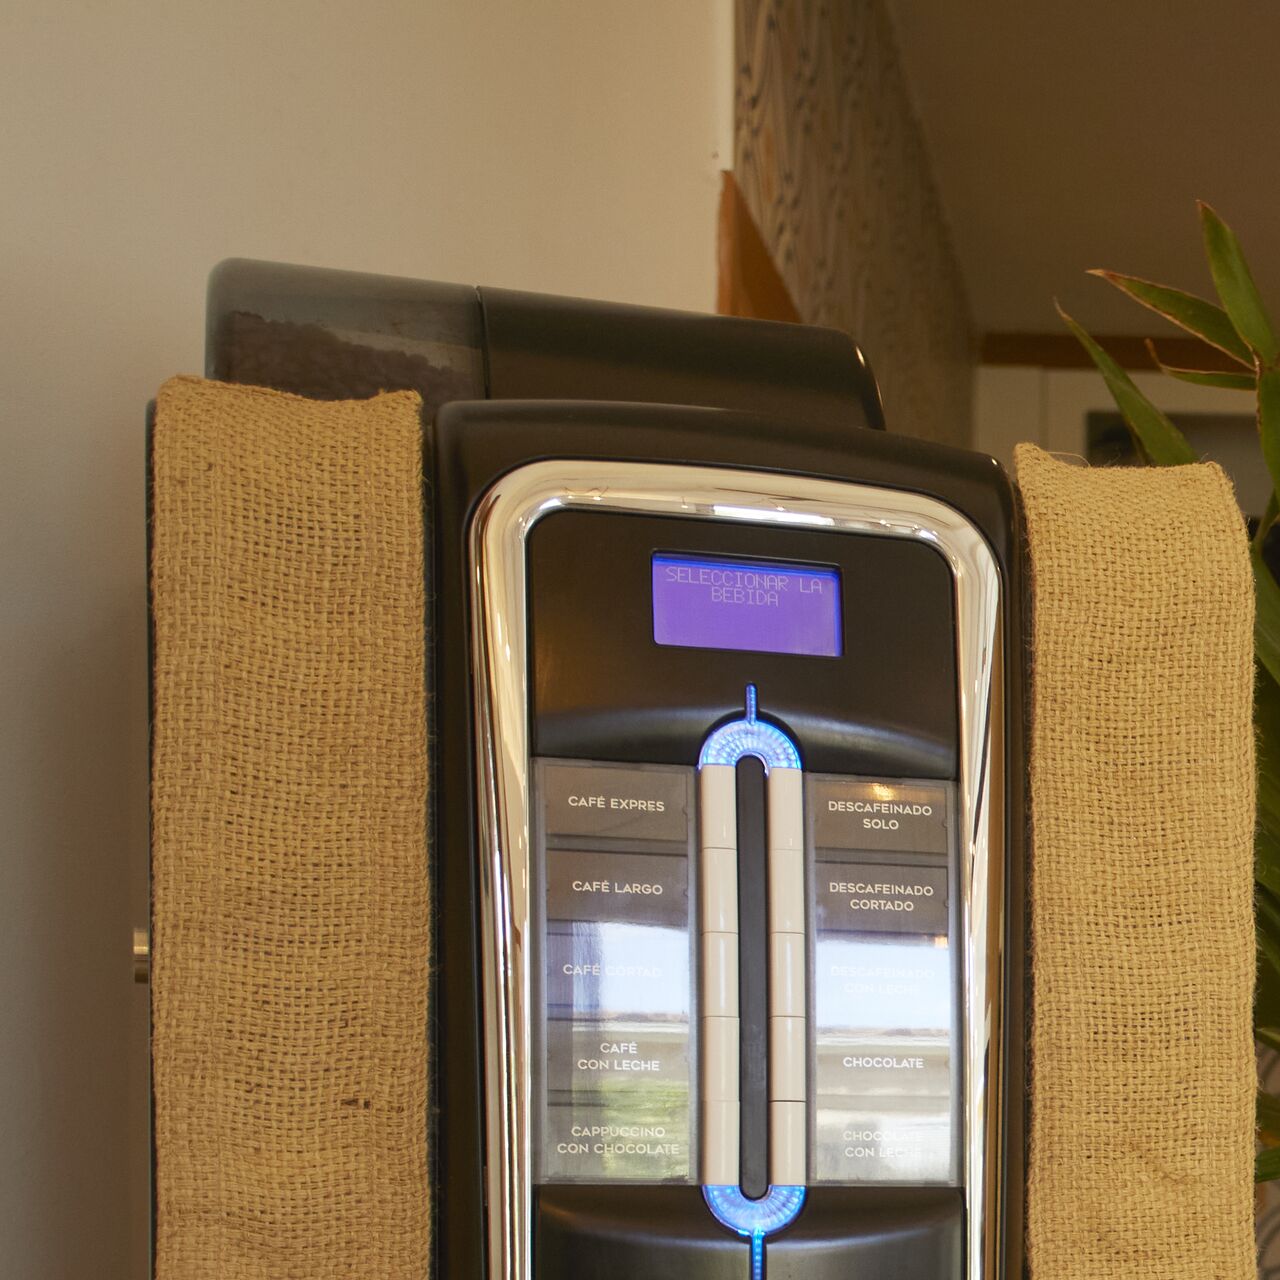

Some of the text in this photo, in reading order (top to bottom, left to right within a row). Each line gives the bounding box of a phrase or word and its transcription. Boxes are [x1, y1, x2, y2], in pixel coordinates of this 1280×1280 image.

[665, 566, 823, 593] SELECCIONAR LA
[711, 587, 779, 607] BEBIDA
[568, 795, 665, 812] CAFÉ EXPRES
[828, 801, 933, 816] DESCAFEINADO
[863, 818, 899, 830] SOLO
[572, 880, 663, 895] CAFÉ LARGO
[829, 882, 934, 896] DESCAFEINADO
[849, 899, 914, 911] CORTADO
[562, 963, 601, 976] CAFÉ
[600, 1041, 638, 1054] CAFÉ
[577, 1059, 661, 1072] CON LECHE
[843, 1056, 924, 1069] CHOCOLATE
[570, 1126, 666, 1137] CAPPUCCINO
[556, 1143, 680, 1155] CON CHOCOLATE
[844, 1147, 875, 1157] CON
